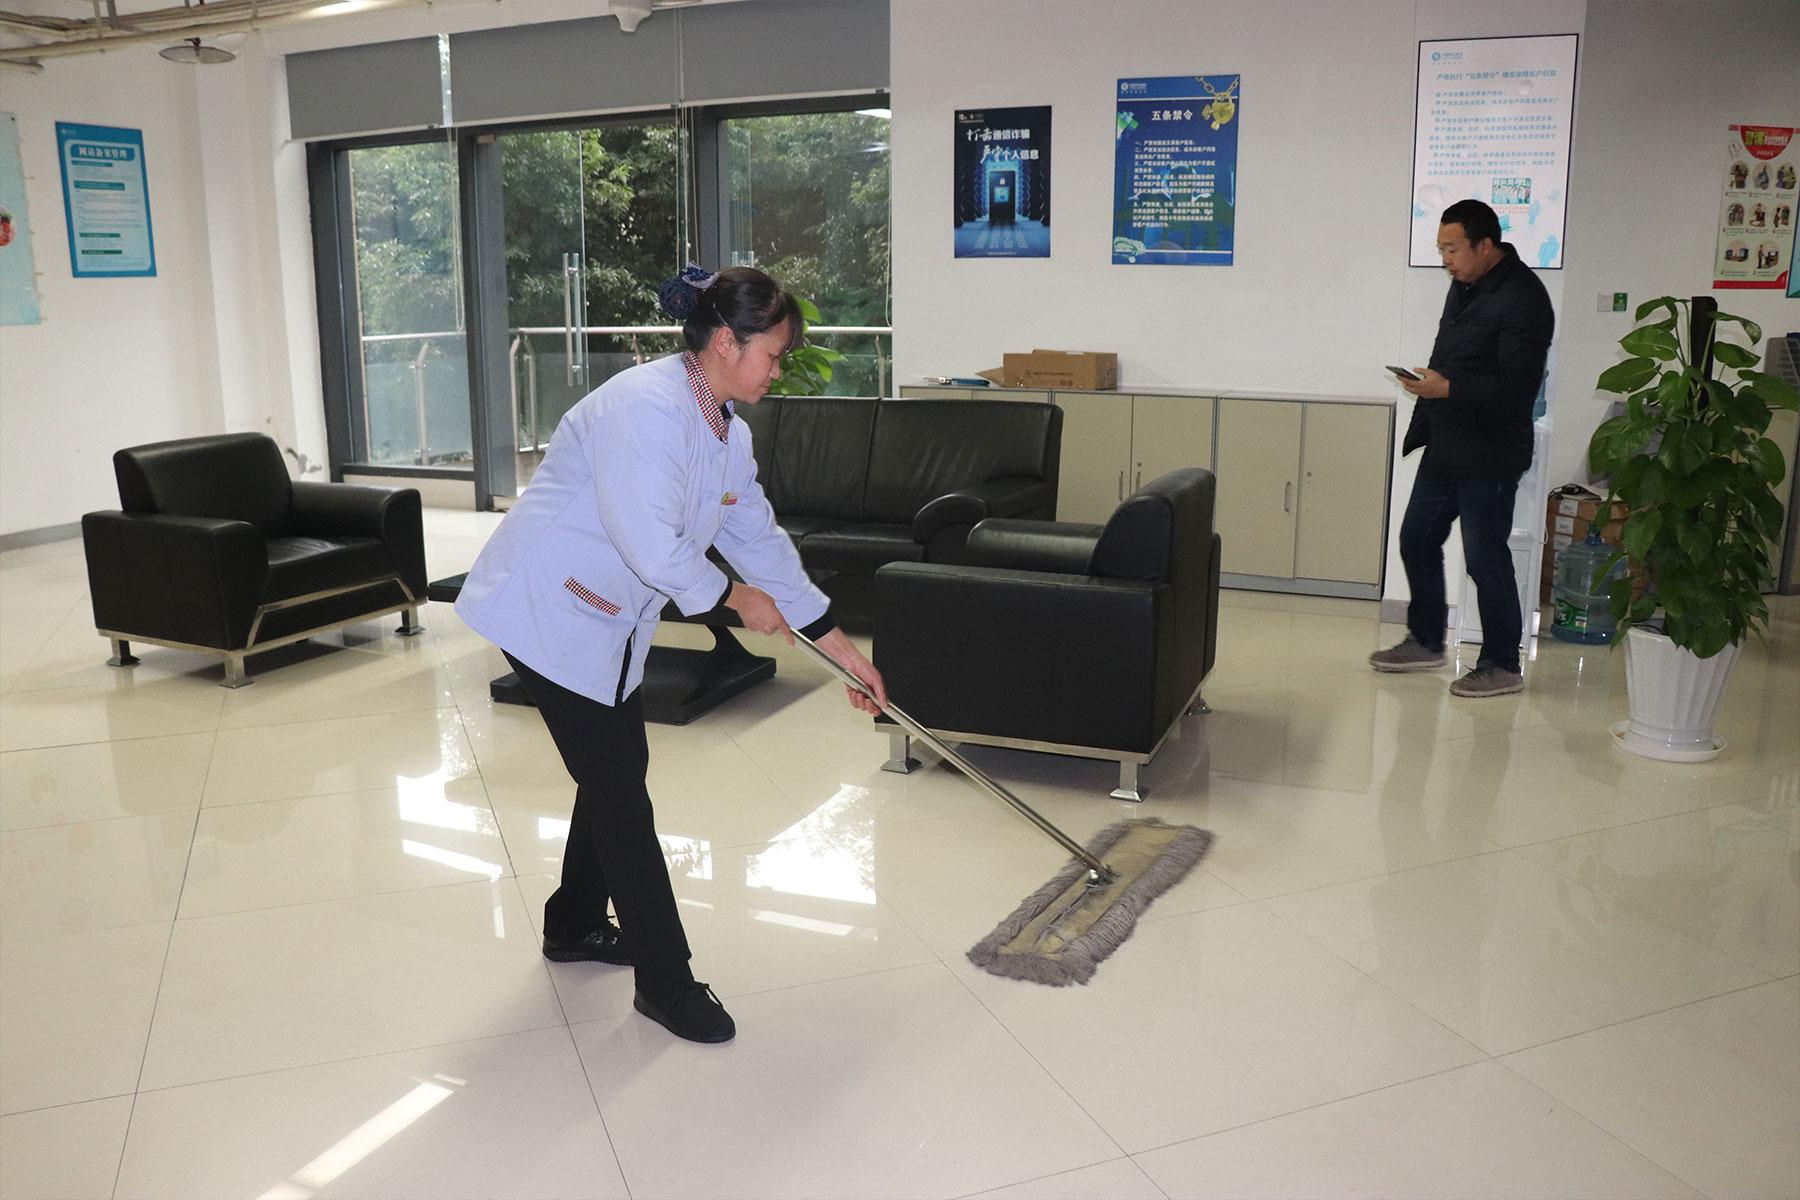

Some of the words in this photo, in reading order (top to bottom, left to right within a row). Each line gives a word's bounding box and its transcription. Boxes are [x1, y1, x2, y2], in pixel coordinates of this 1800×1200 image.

[1151, 109, 1193, 121] 五条禁令
[966, 127, 1031, 142] 打击通信诈骗
[979, 144, 1039, 164] 严守个人信息
